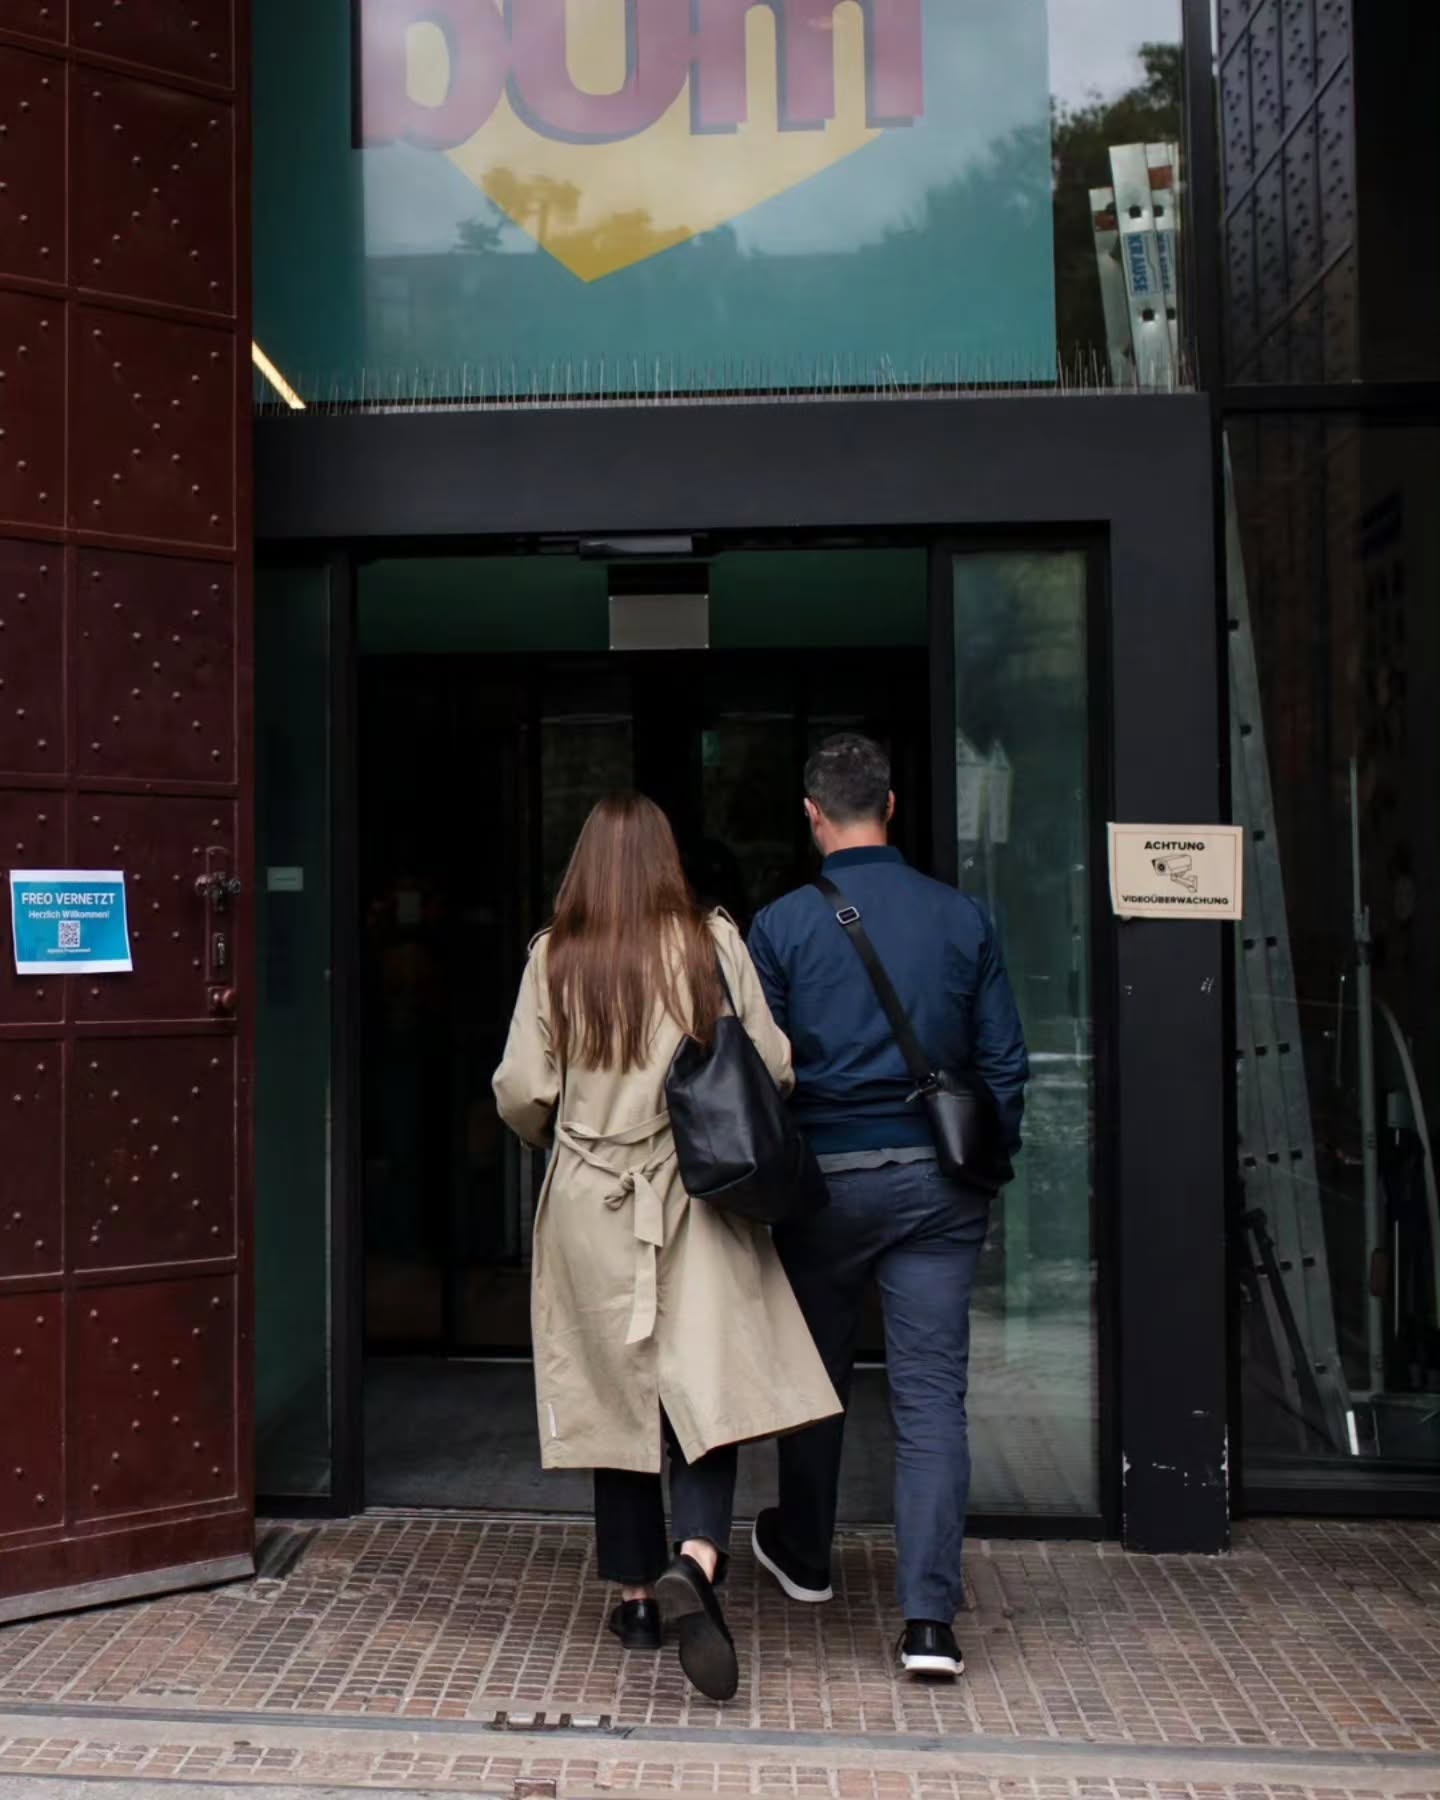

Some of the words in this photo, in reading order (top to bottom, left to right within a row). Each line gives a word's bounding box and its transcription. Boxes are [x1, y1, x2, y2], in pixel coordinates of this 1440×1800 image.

[1127, 234, 1149, 292] KRAUSE
[1144, 841, 1205, 851] ACHTUNG
[21, 892, 53, 905] FREO
[55, 892, 116, 905] VERNETZT
[1122, 895, 1229, 905] VIDEOÜBERWACHUNG
[28, 910, 60, 919] Herzlich
[62, 910, 110, 919] Willkommen!
